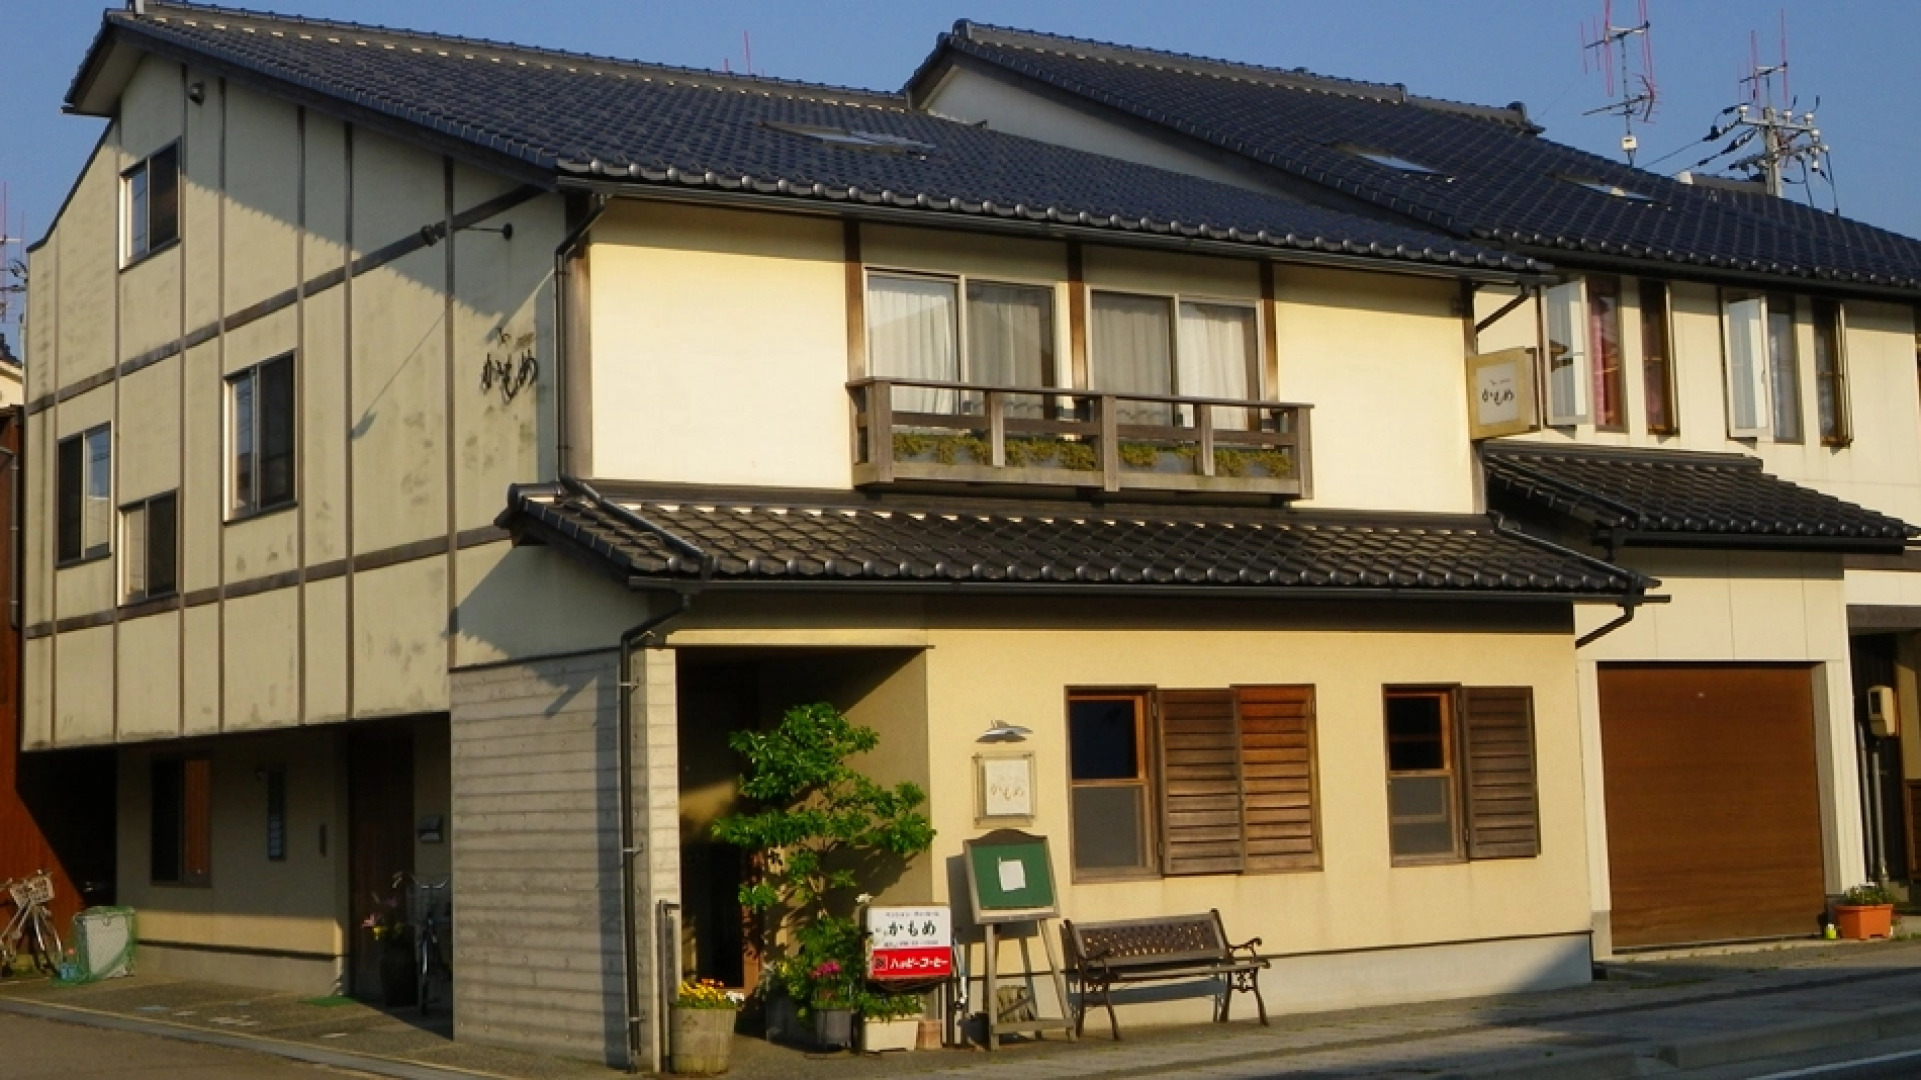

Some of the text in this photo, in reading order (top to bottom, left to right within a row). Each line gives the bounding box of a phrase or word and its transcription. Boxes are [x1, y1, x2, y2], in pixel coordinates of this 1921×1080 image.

[480, 347, 539, 404] かもめ
[1481, 387, 1515, 406] かもめ
[990, 784, 1025, 801] かもめ
[888, 919, 937, 937] かもめ
[889, 955, 949, 970] ハッピーコーヒー
